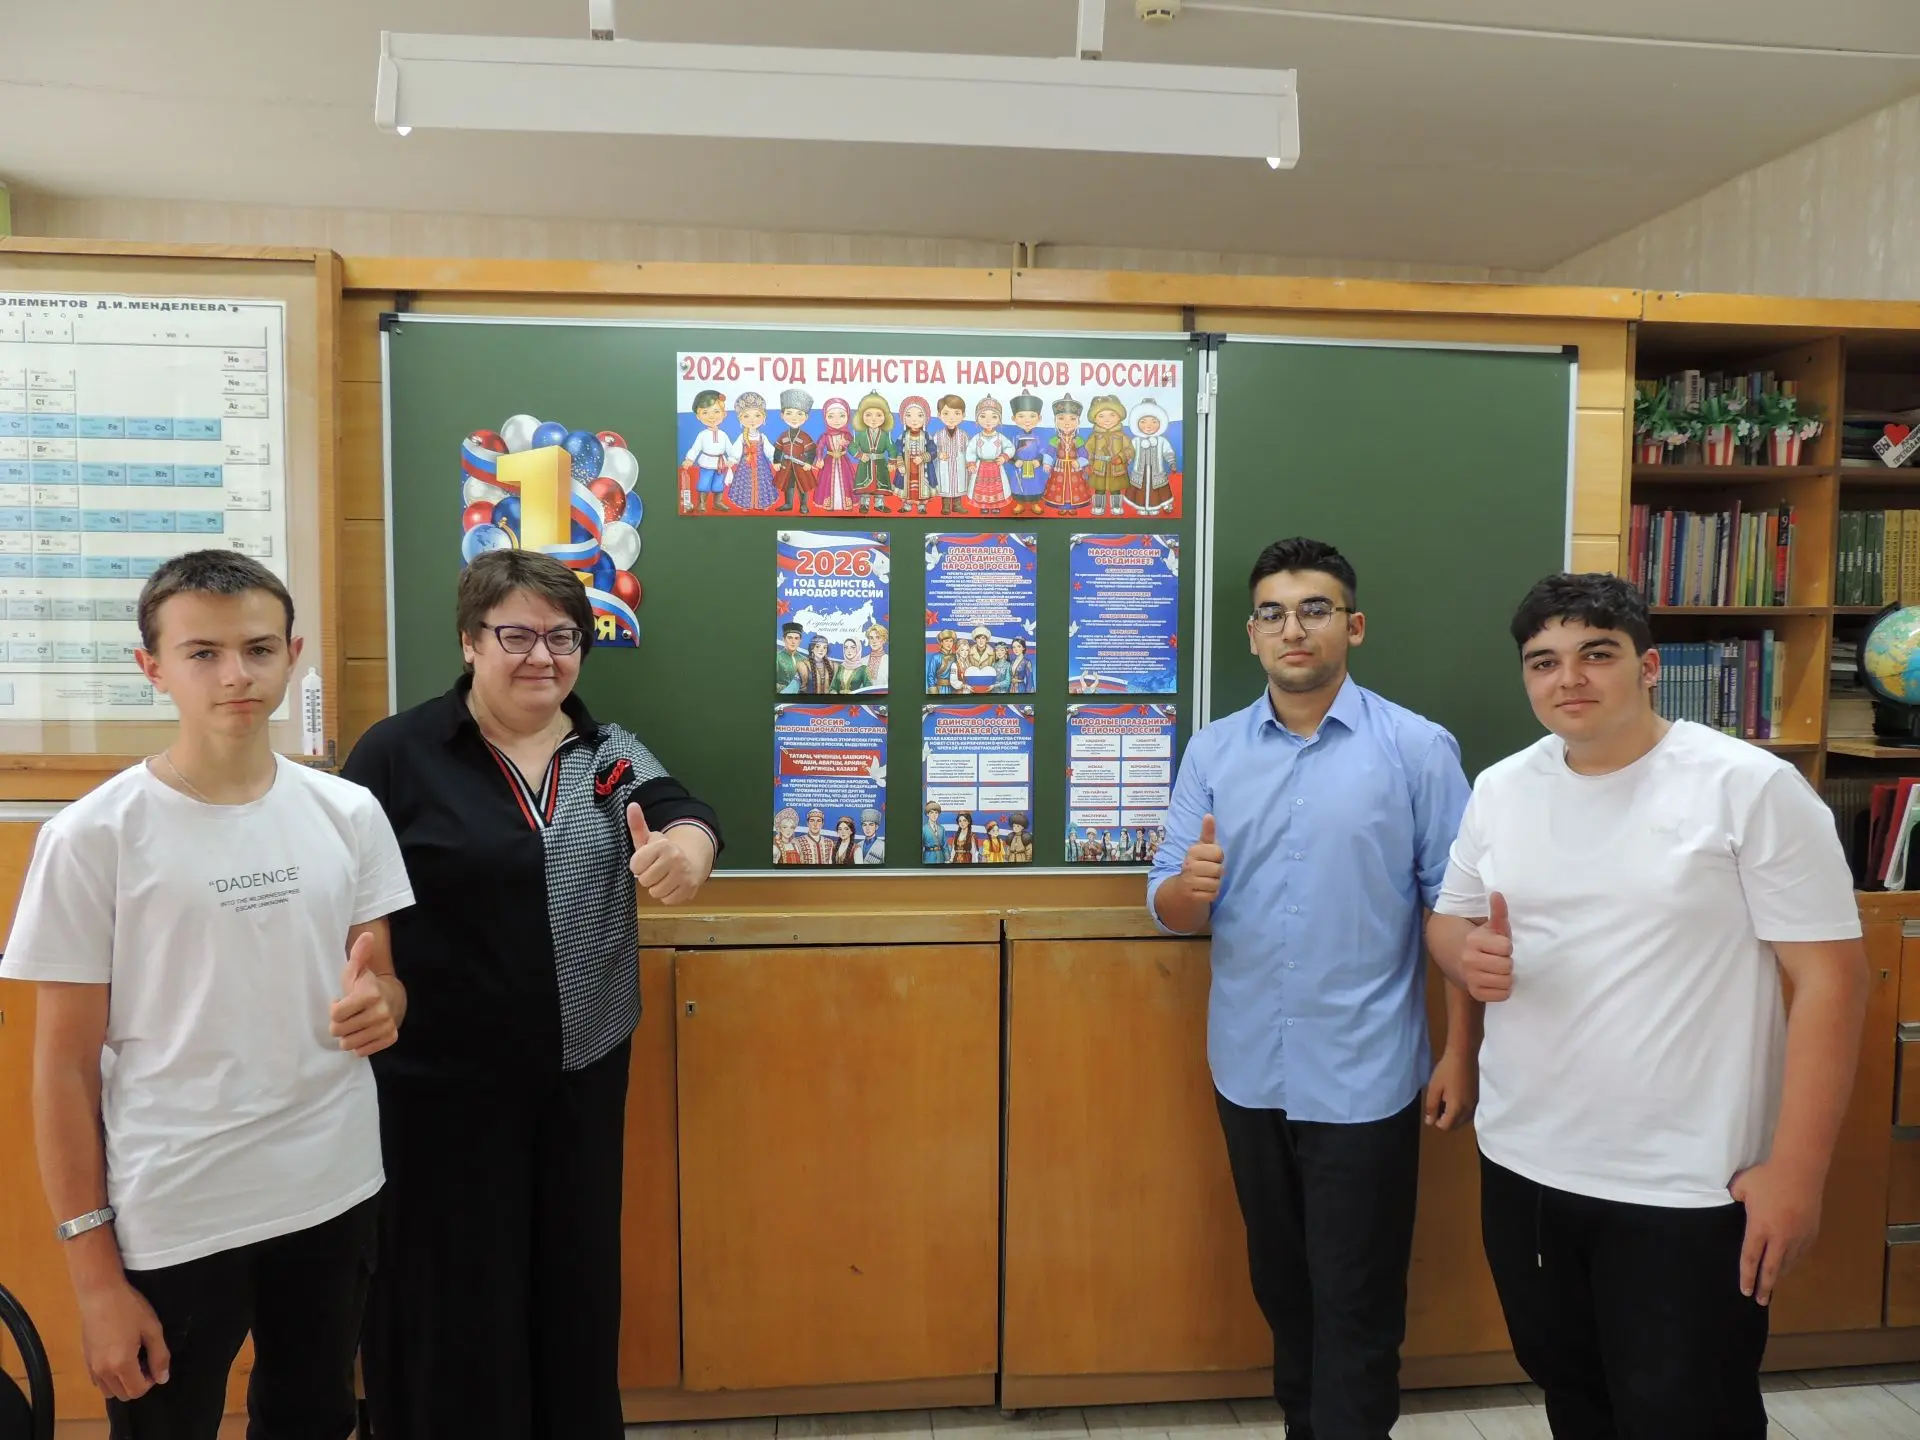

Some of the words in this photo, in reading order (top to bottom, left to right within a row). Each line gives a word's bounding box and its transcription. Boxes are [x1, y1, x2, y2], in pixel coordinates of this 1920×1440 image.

[96, 300, 227, 312] Д.И.МЕНДЕЛЕЕВА
[817, 358, 946, 385] ЕДИНСТВА
[956, 360, 1070, 387] НАРОДОВ
[1080, 362, 1176, 388] РОССИИ
[1875, 436, 1892, 456] ВЫ
[497, 445, 571, 550] 1
[948, 547, 990, 555] ГЛАВНАЯ
[990, 547, 1014, 555] ЦЕЛЬ
[1088, 548, 1125, 556] НАРОДЫ
[1126, 549, 1161, 557] РОССИИ
[796, 550, 872, 578] 2026
[971, 555, 1017, 563] ЕДИНСТВА
[793, 579, 816, 588] ГОД
[818, 579, 876, 589] ЕДИНСТВА
[784, 588, 838, 598] НАРОДОВ
[840, 589, 884, 598] РОССИИ
[810, 718, 844, 726] РОССИЯ
[937, 718, 983, 726] ЕДИНСТВО
[984, 719, 1019, 727] РОССИИ
[1081, 726, 1126, 734] РЕГИОНОВ
[1127, 726, 1161, 734] РОССИИ
